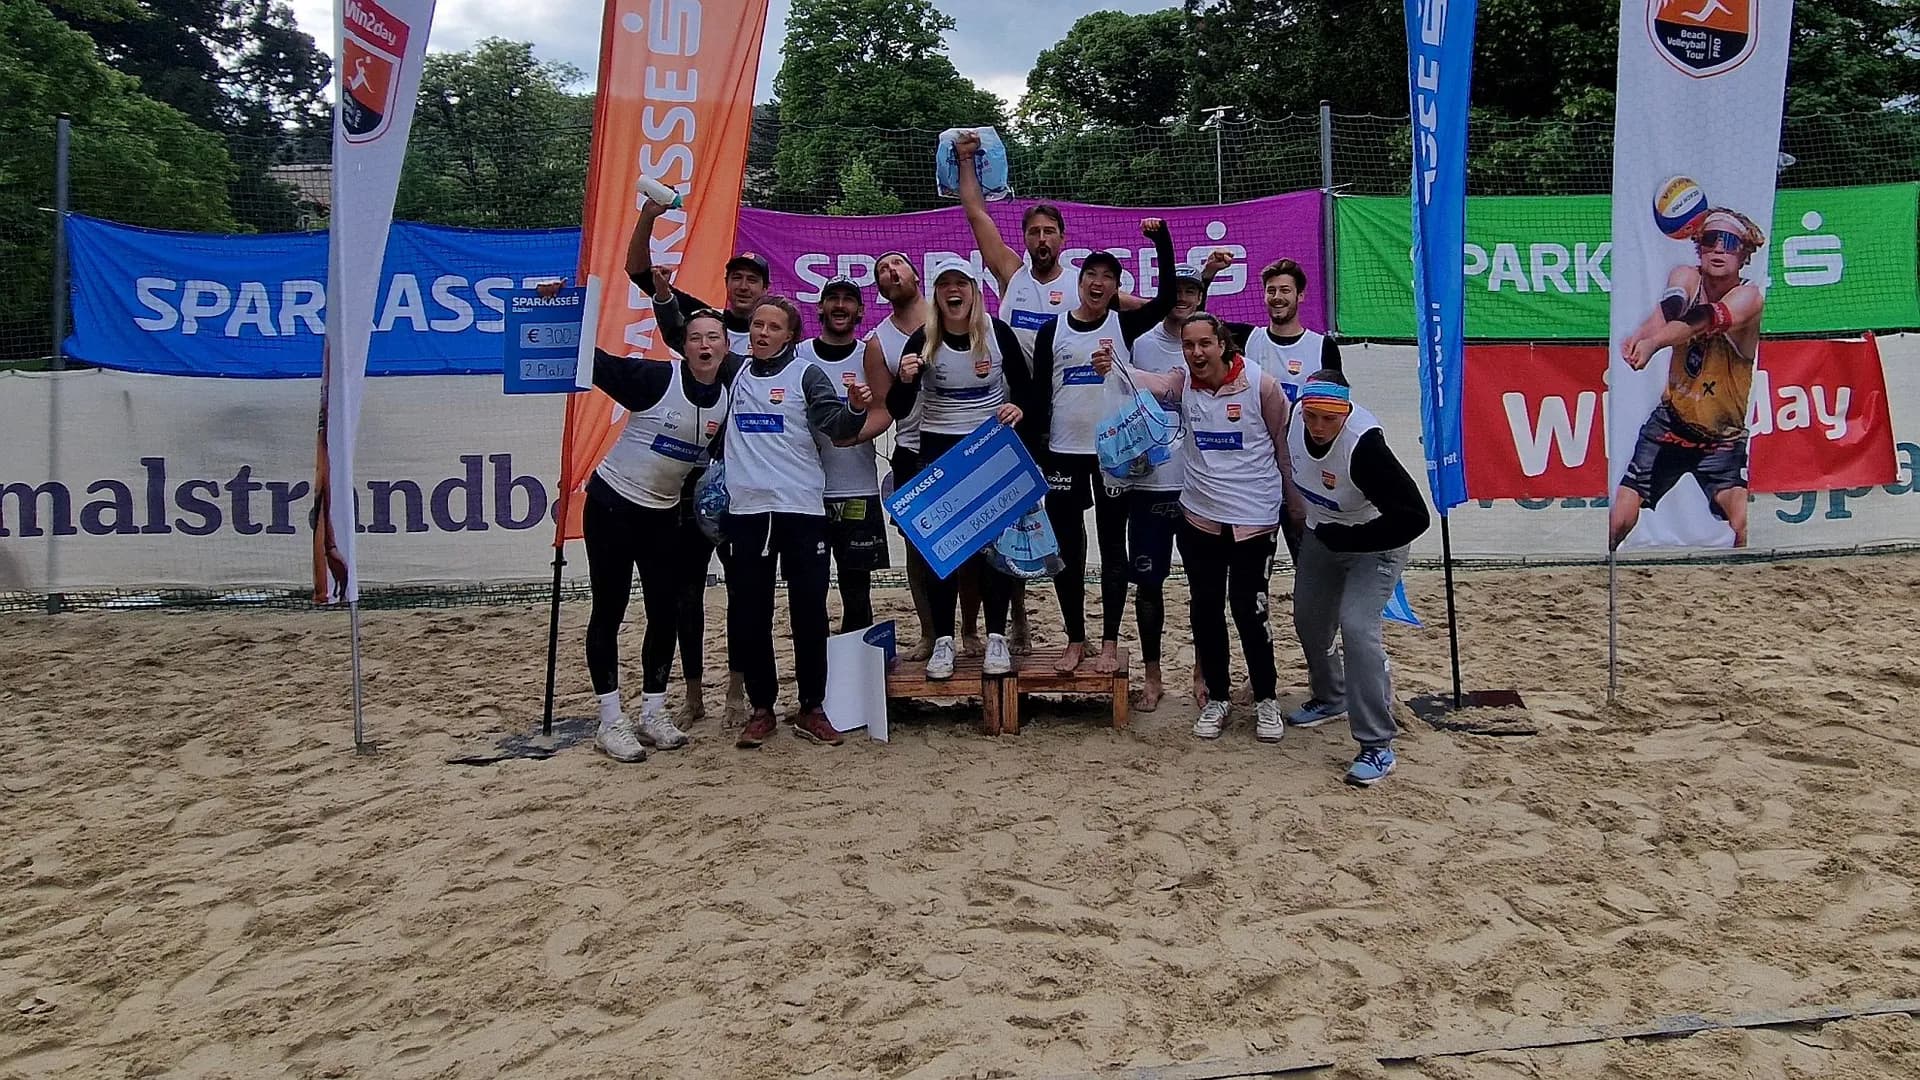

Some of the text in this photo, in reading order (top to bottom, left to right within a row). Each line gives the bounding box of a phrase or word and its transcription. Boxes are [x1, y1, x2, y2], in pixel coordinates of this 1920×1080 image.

[1667, 37, 1707, 50] Volleyball
[1680, 29, 1707, 40] Beach
[1686, 49, 1705, 60] Tour
[1712, 38, 1722, 58] PRO
[133, 274, 562, 337] SPARASS
[512, 295, 572, 307] SPARKASSE
[0, 453, 563, 537] malstrndb
[892, 474, 937, 512] SPARKASSE
[969, 508, 998, 532] BADEN
